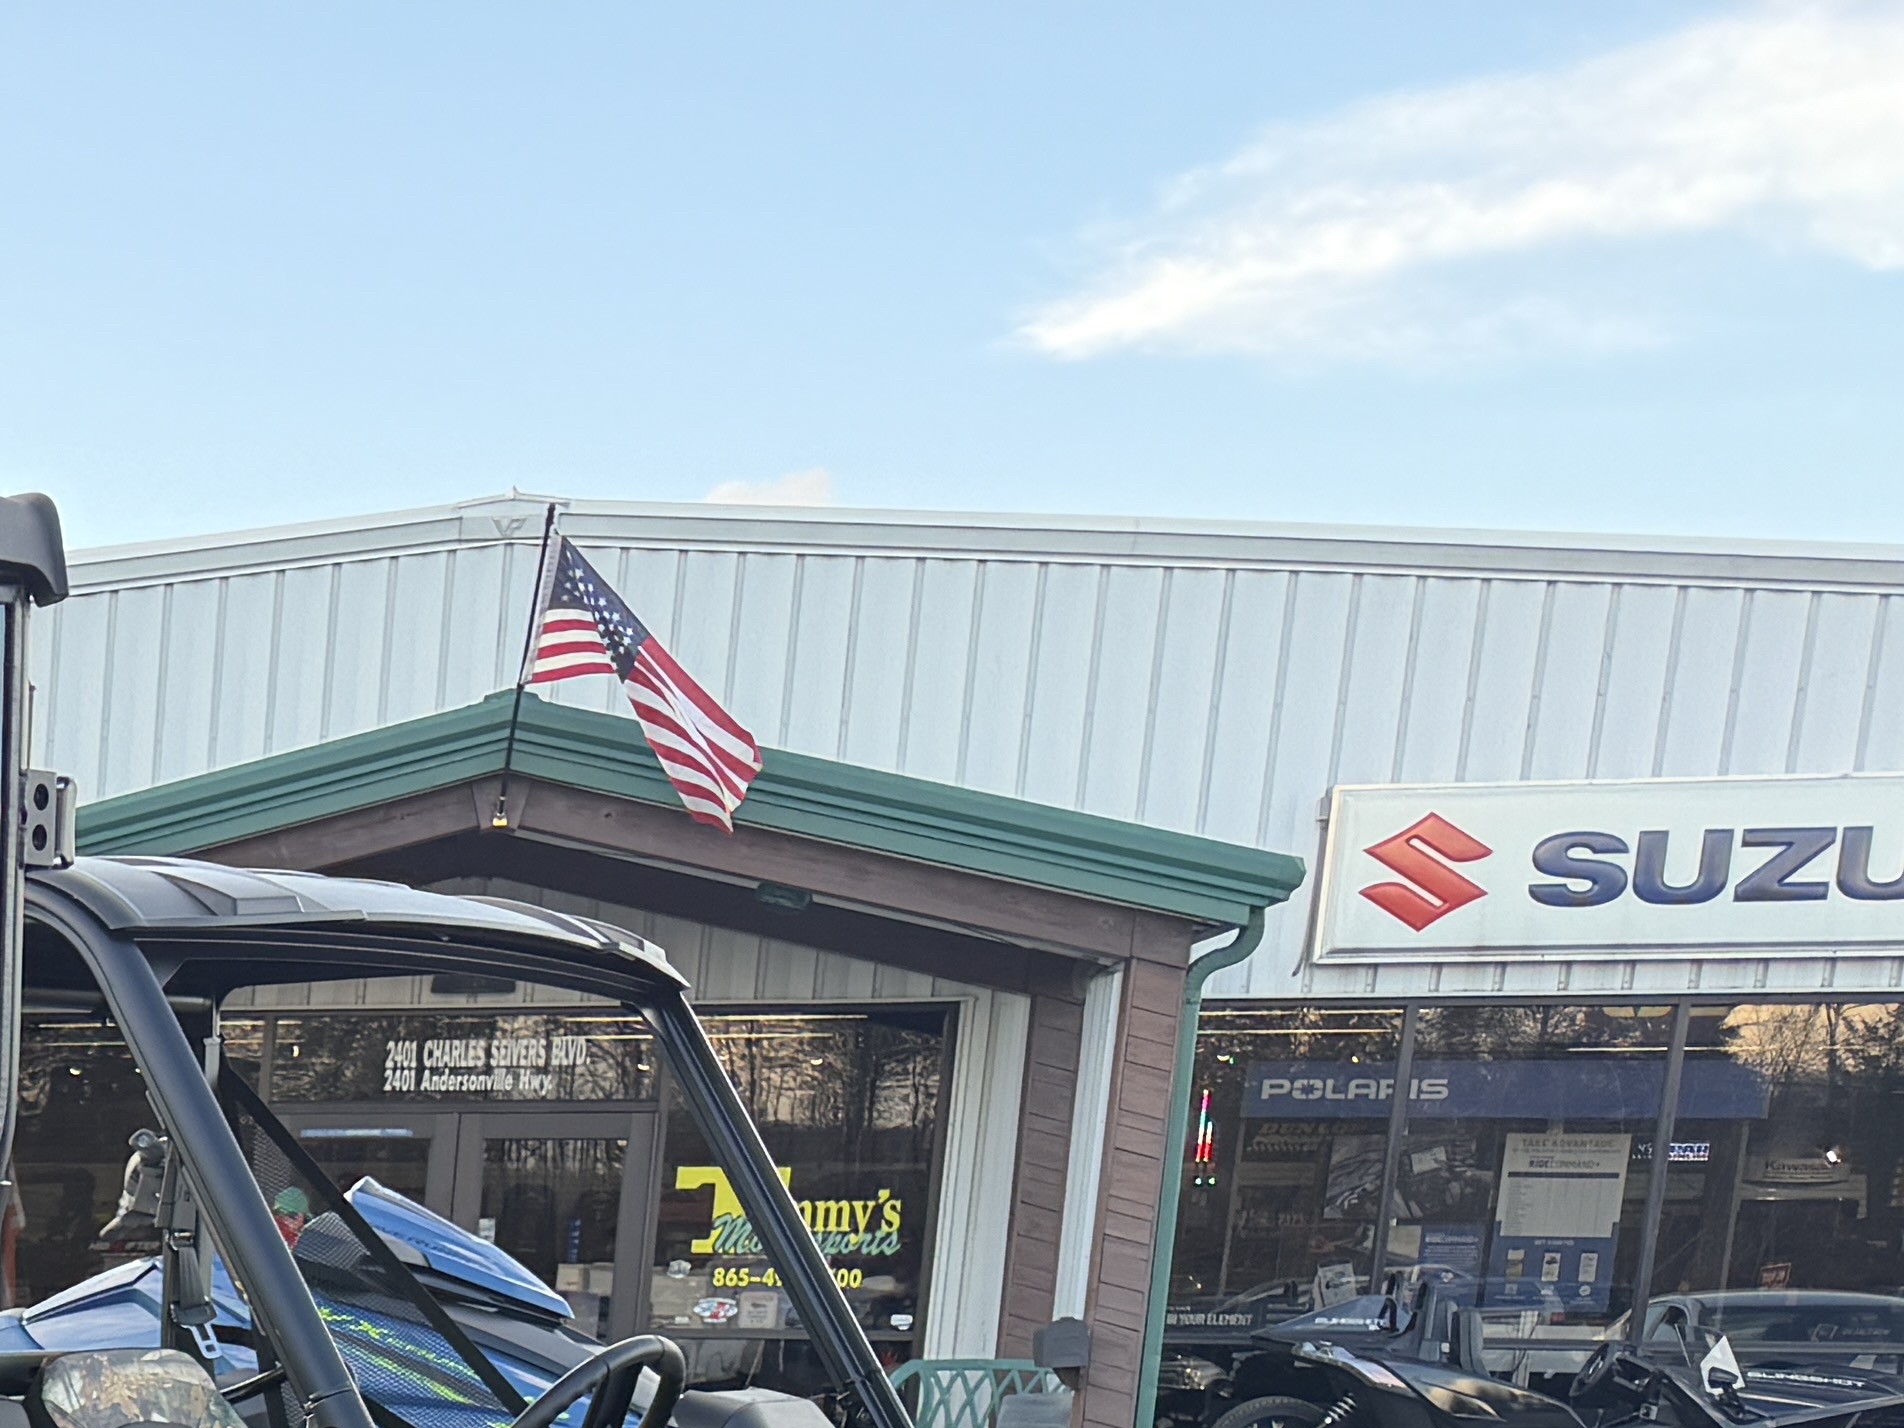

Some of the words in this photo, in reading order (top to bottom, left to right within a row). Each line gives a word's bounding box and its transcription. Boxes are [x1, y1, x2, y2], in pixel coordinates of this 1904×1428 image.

[385, 1040, 417, 1068] 2401
[423, 1039, 486, 1068] CHARLES
[490, 1038, 546, 1067] SEIVERS
[551, 1037, 590, 1066] BLVD.
[383, 1069, 415, 1091] 2401
[420, 1069, 512, 1091] Andersonville
[519, 1068, 552, 1095] Hwy.
[1261, 1079, 1449, 1100] POLARIS
